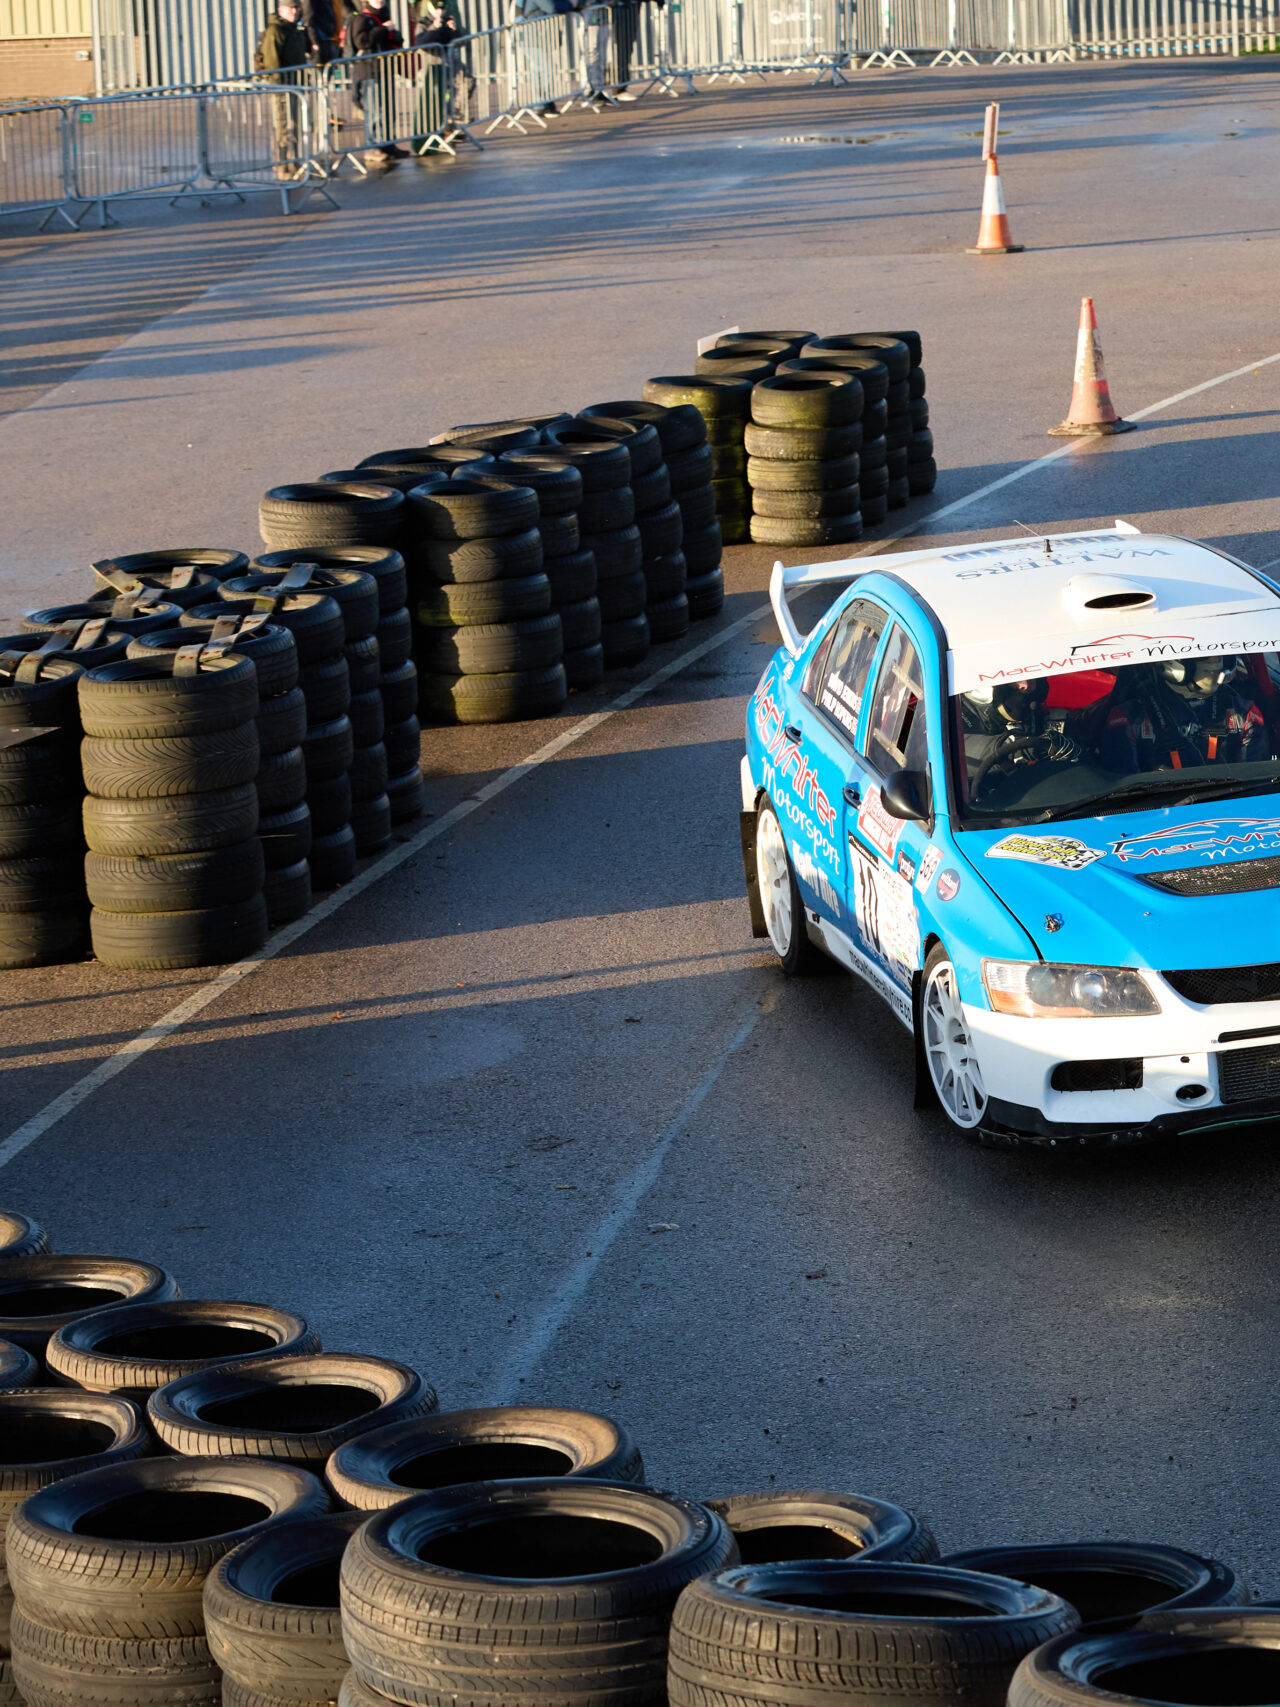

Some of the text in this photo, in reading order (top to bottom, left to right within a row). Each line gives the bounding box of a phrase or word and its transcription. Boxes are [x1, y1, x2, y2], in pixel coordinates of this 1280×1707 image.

[955, 549, 1177, 580] WALTERS
[978, 650, 1134, 682] MacWhirter
[754, 660, 837, 839] MacWhirter
[762, 756, 841, 876] Motorsport
[920, 853, 938, 882] 569
[859, 858, 881, 953] 10
